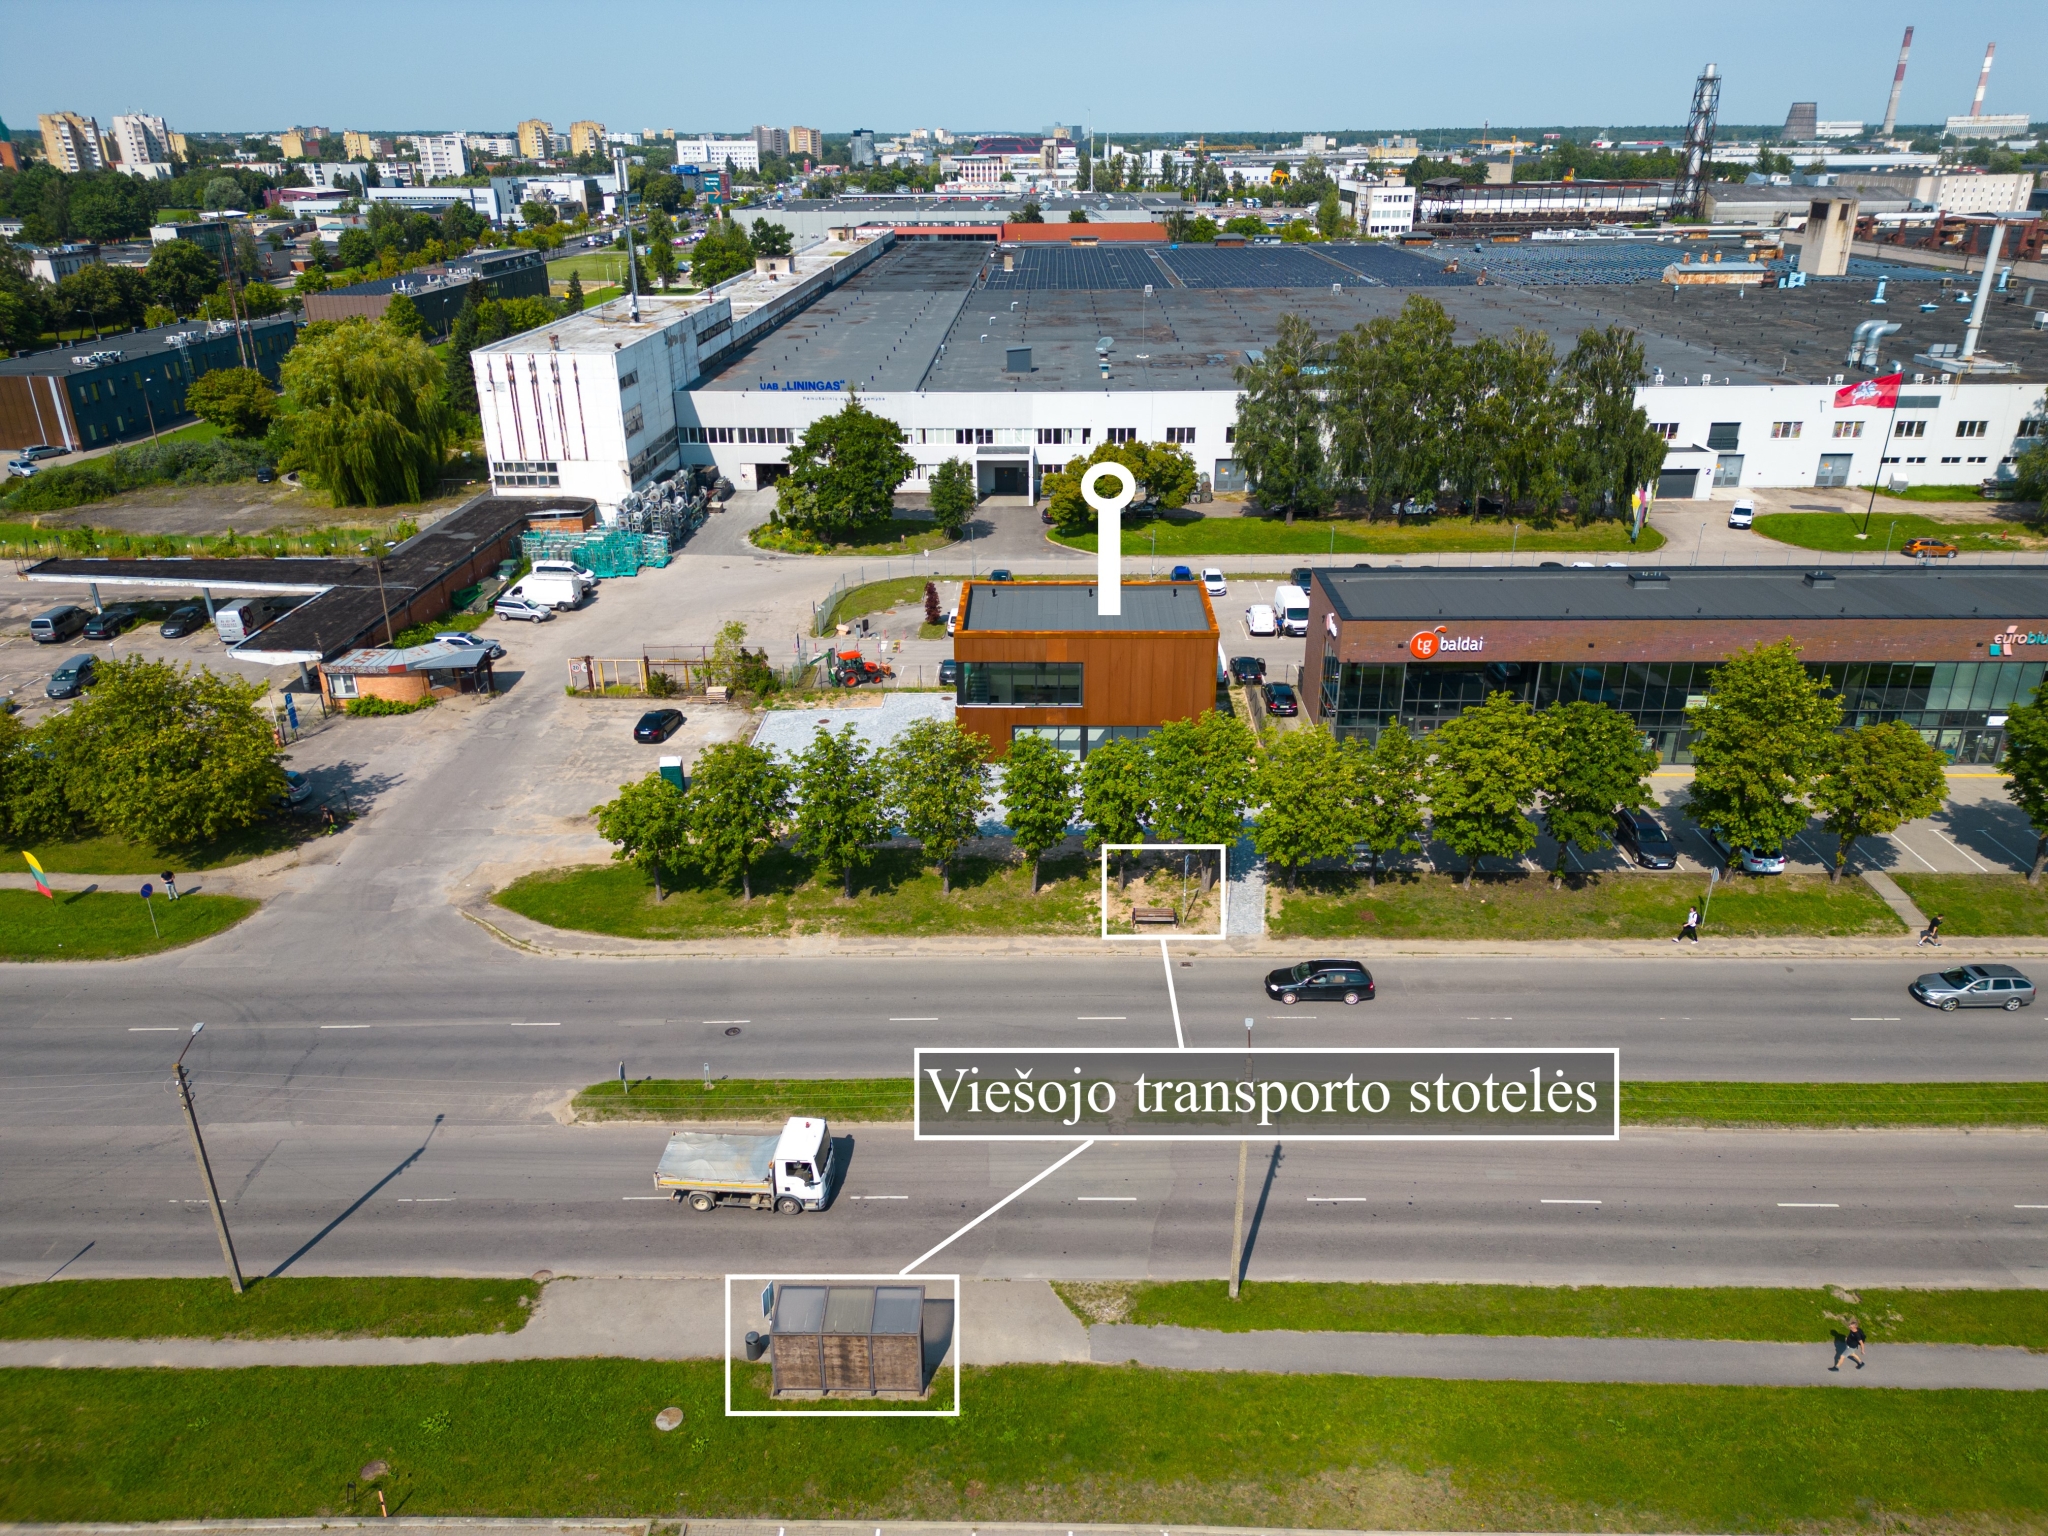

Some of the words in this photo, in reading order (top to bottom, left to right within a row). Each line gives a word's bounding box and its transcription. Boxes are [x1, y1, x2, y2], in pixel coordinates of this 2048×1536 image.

[760, 382, 779, 390] UAB
[1417, 638, 1432, 654] tg
[1440, 636, 1483, 651] baldai
